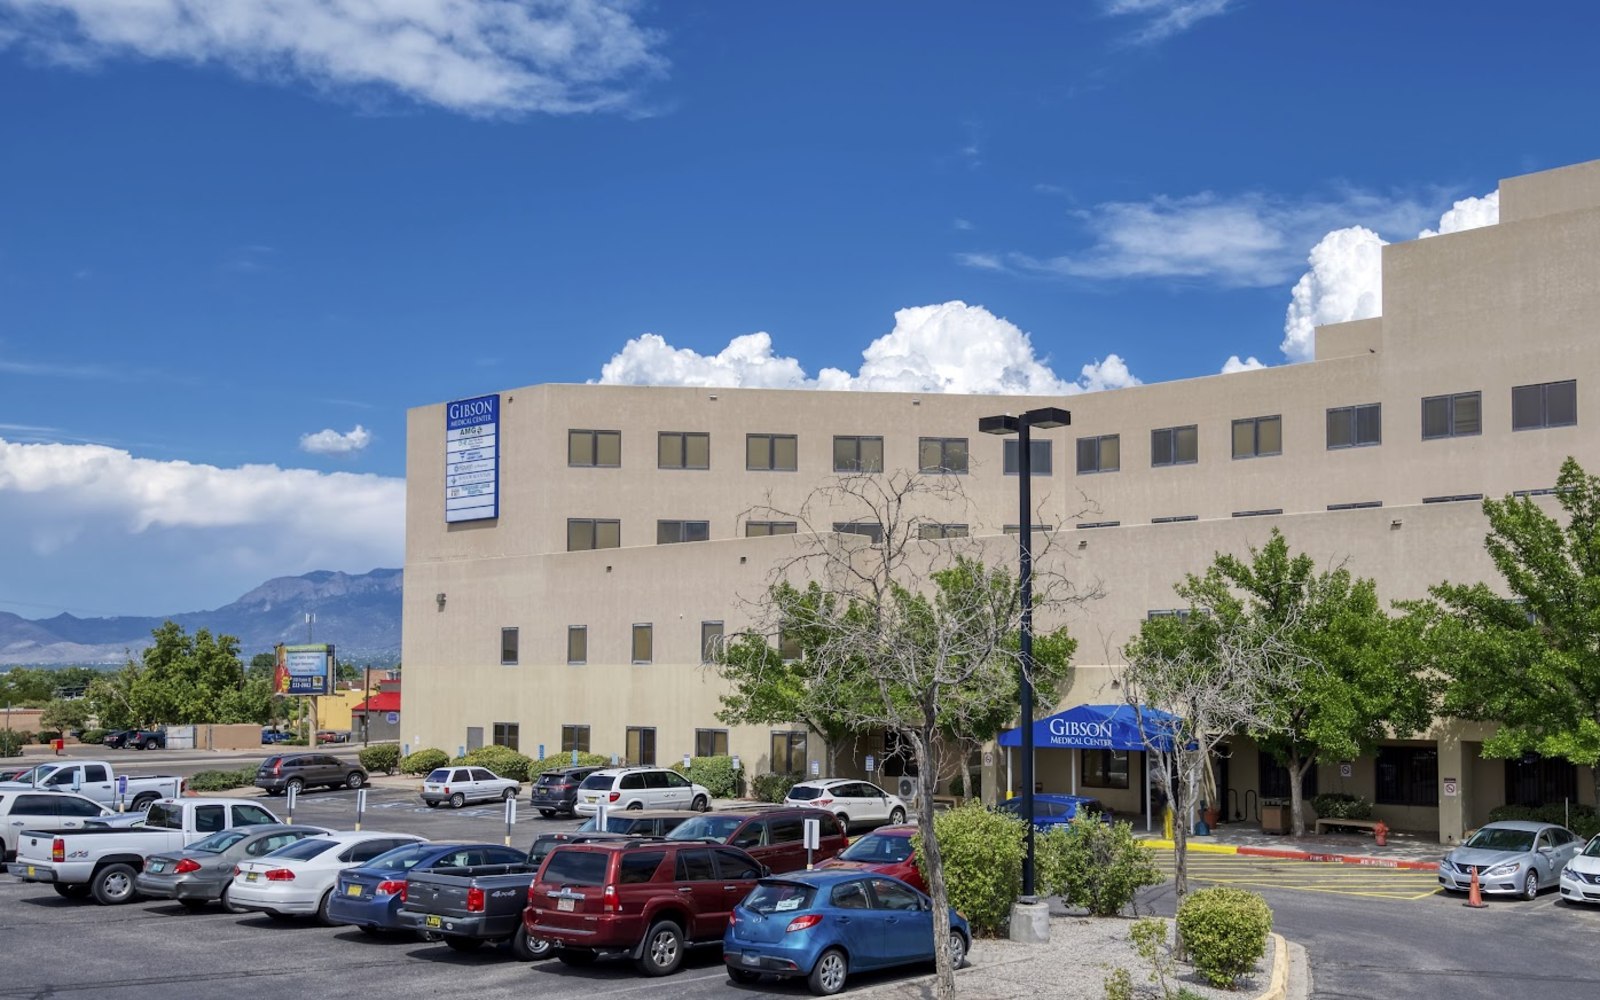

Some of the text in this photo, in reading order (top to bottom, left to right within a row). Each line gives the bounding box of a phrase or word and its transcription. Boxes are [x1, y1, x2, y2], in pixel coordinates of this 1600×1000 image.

[450, 400, 493, 419] GIBSON
[451, 414, 492, 427] MEDICAL CENTER
[460, 427, 476, 435] AMG
[1050, 718, 1112, 737] GIBSON
[1050, 736, 1113, 747] MEDICAL CENTER
